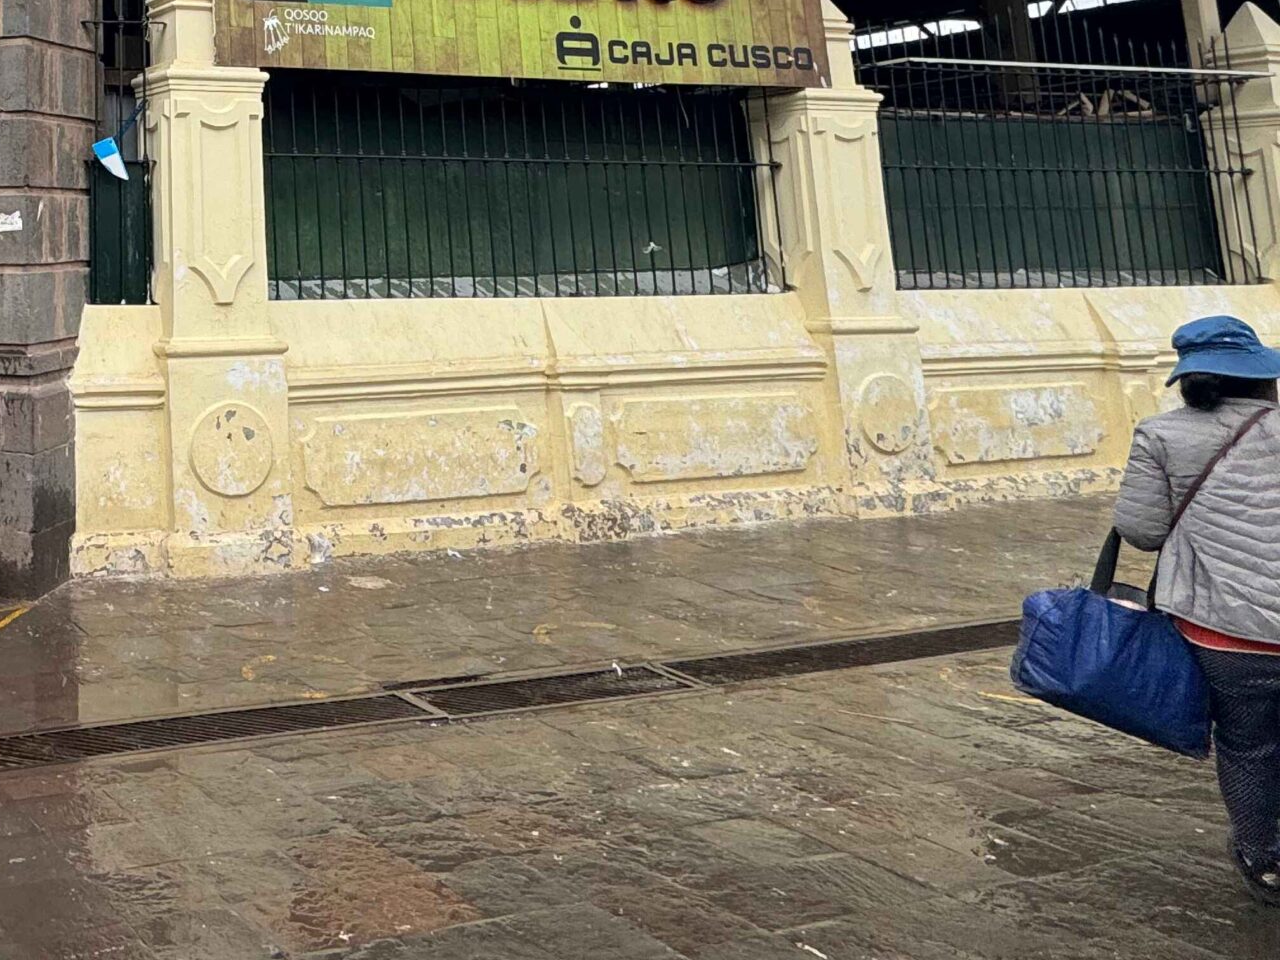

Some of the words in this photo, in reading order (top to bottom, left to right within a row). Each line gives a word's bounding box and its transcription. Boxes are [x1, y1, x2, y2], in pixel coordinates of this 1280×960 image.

[284, 8, 328, 22] QOSQO
[608, 41, 697, 67] CAJA
[707, 44, 814, 71] CUSCO
